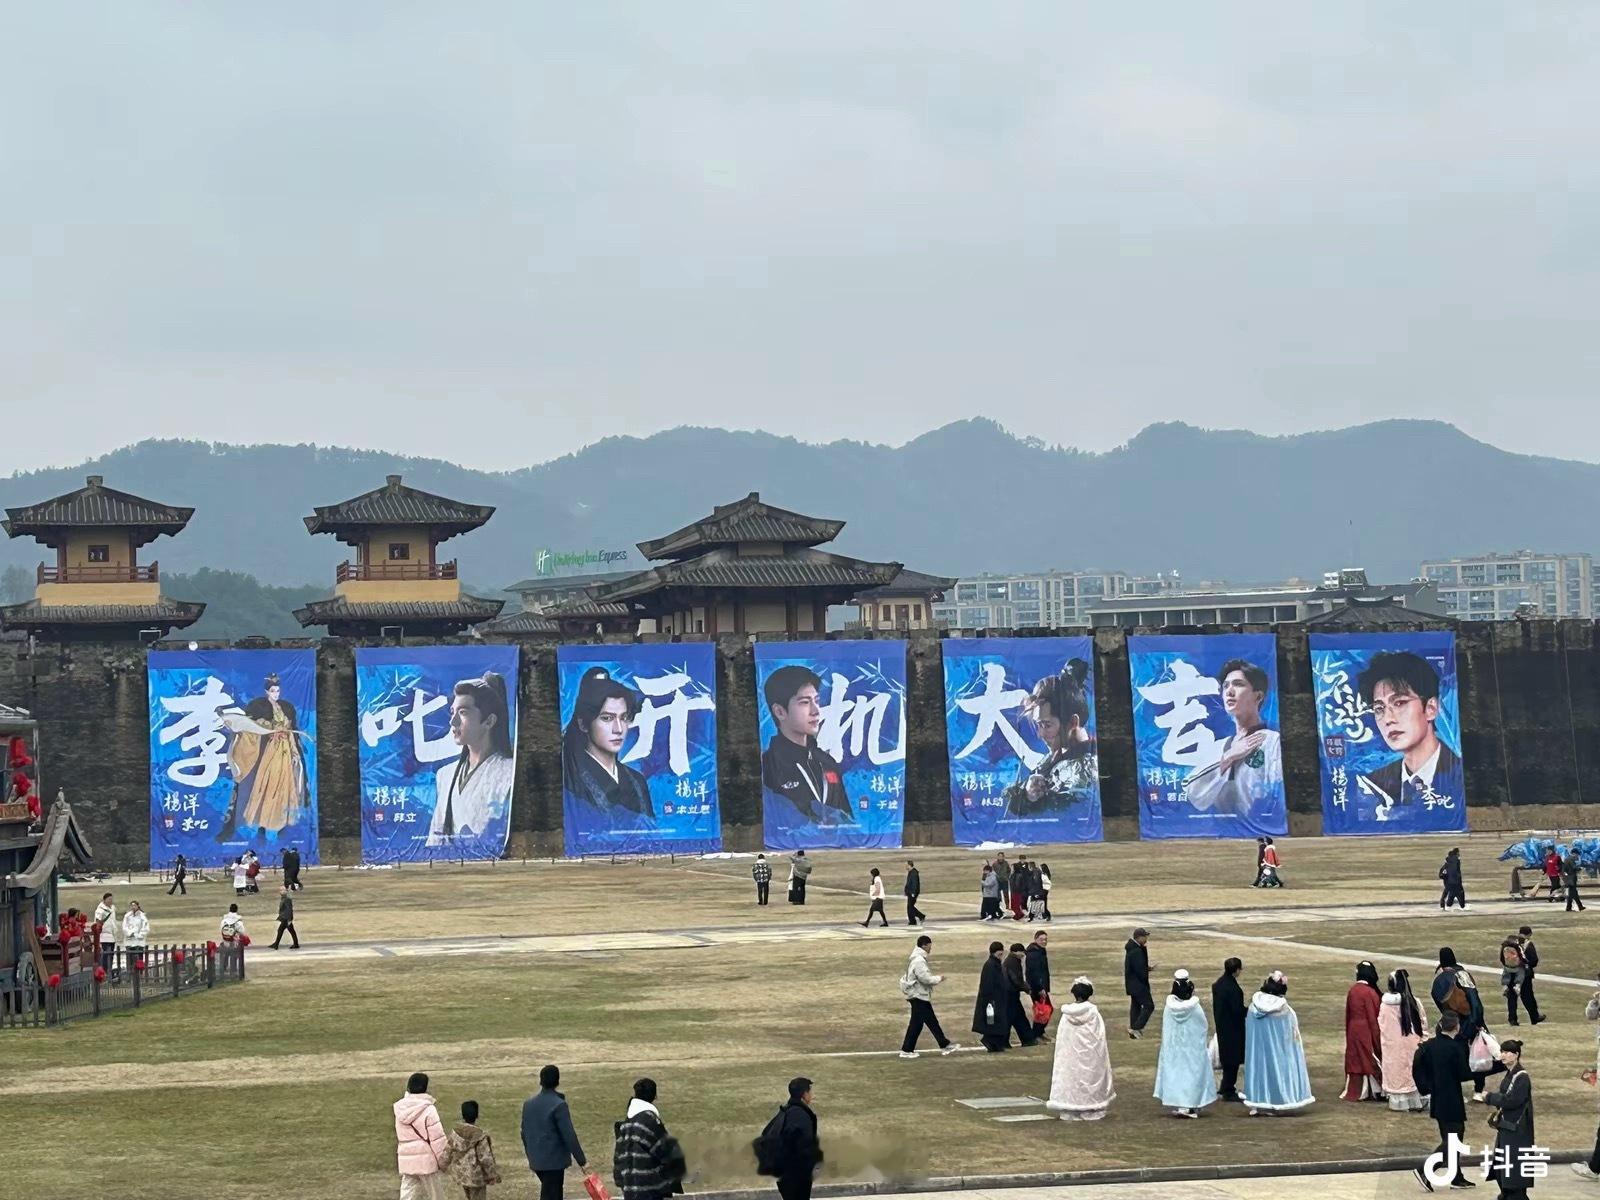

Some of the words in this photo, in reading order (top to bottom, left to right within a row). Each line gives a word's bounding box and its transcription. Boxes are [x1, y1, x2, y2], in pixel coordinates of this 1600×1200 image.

[160, 676, 245, 787] 李
[361, 689, 464, 763] 叱
[621, 673, 716, 776] 开
[816, 672, 906, 765] 机
[954, 662, 1049, 771] 大
[1136, 658, 1232, 767] 吉
